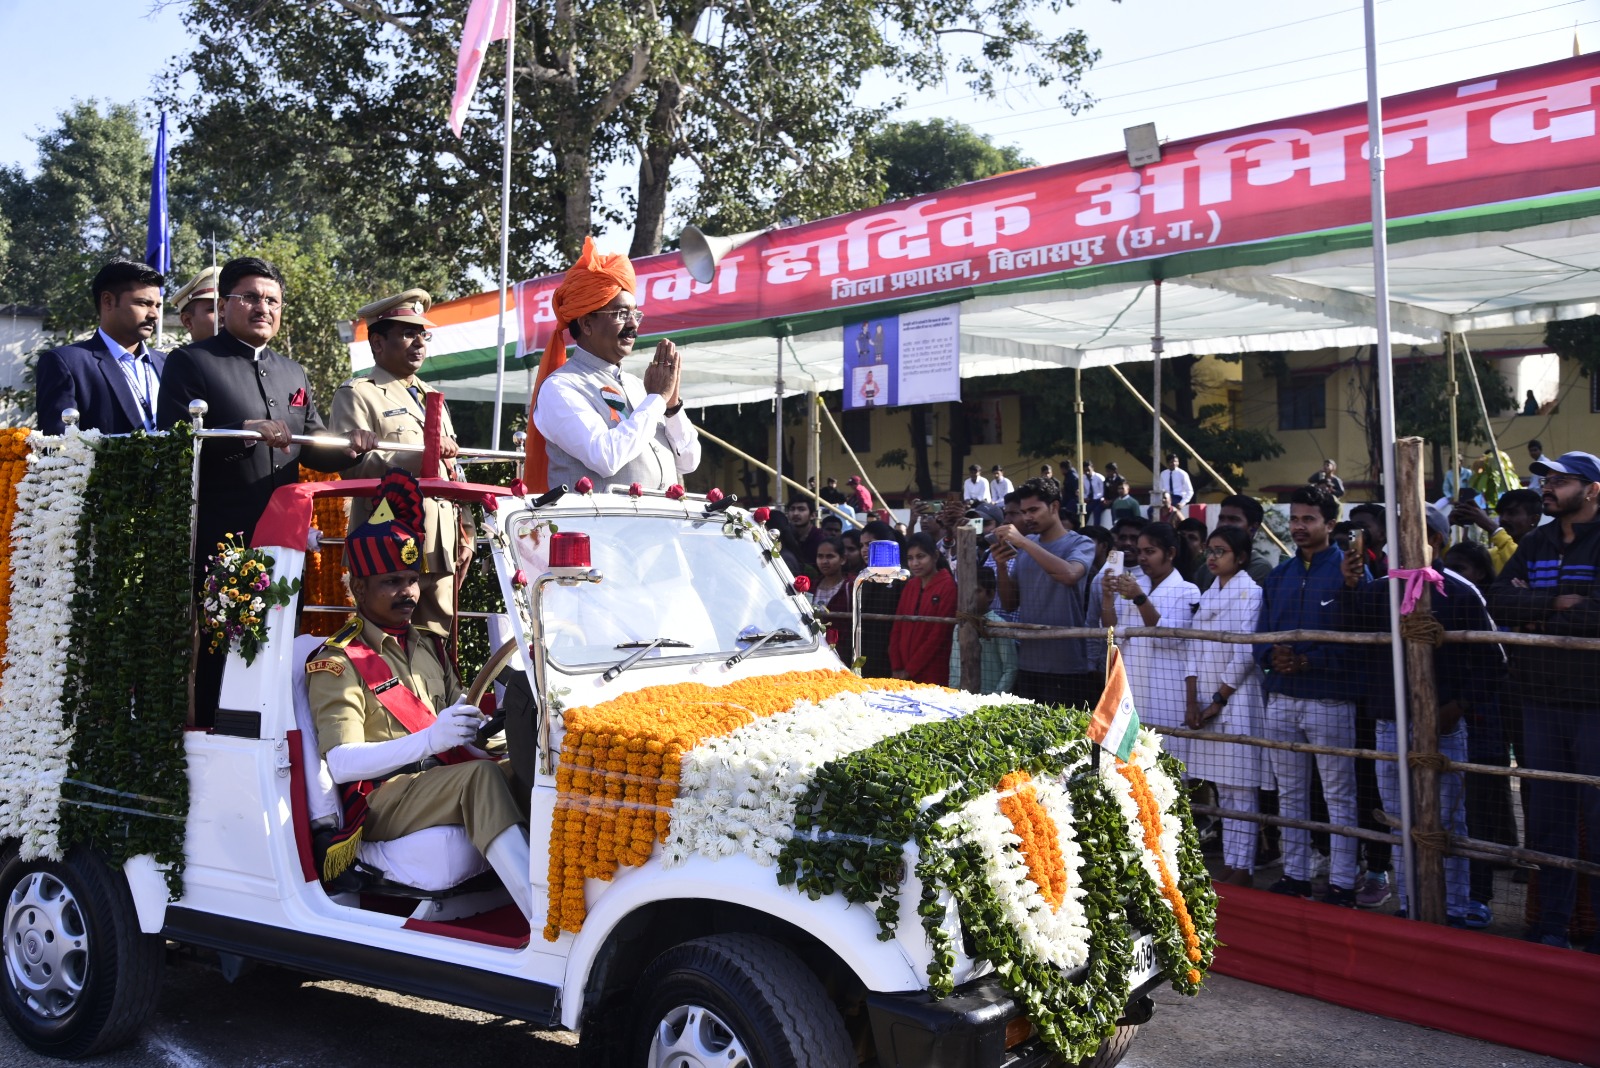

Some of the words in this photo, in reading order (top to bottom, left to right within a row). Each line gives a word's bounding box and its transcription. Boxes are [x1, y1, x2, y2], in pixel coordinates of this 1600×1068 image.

[762, 192, 1036, 285] हार्दिक
[831, 274, 886, 300] जिला
[890, 259, 980, 292] प्रशासन,
[988, 235, 1106, 274] बिलासपुर
[1116, 209, 1221, 257] (छ.ग.)
